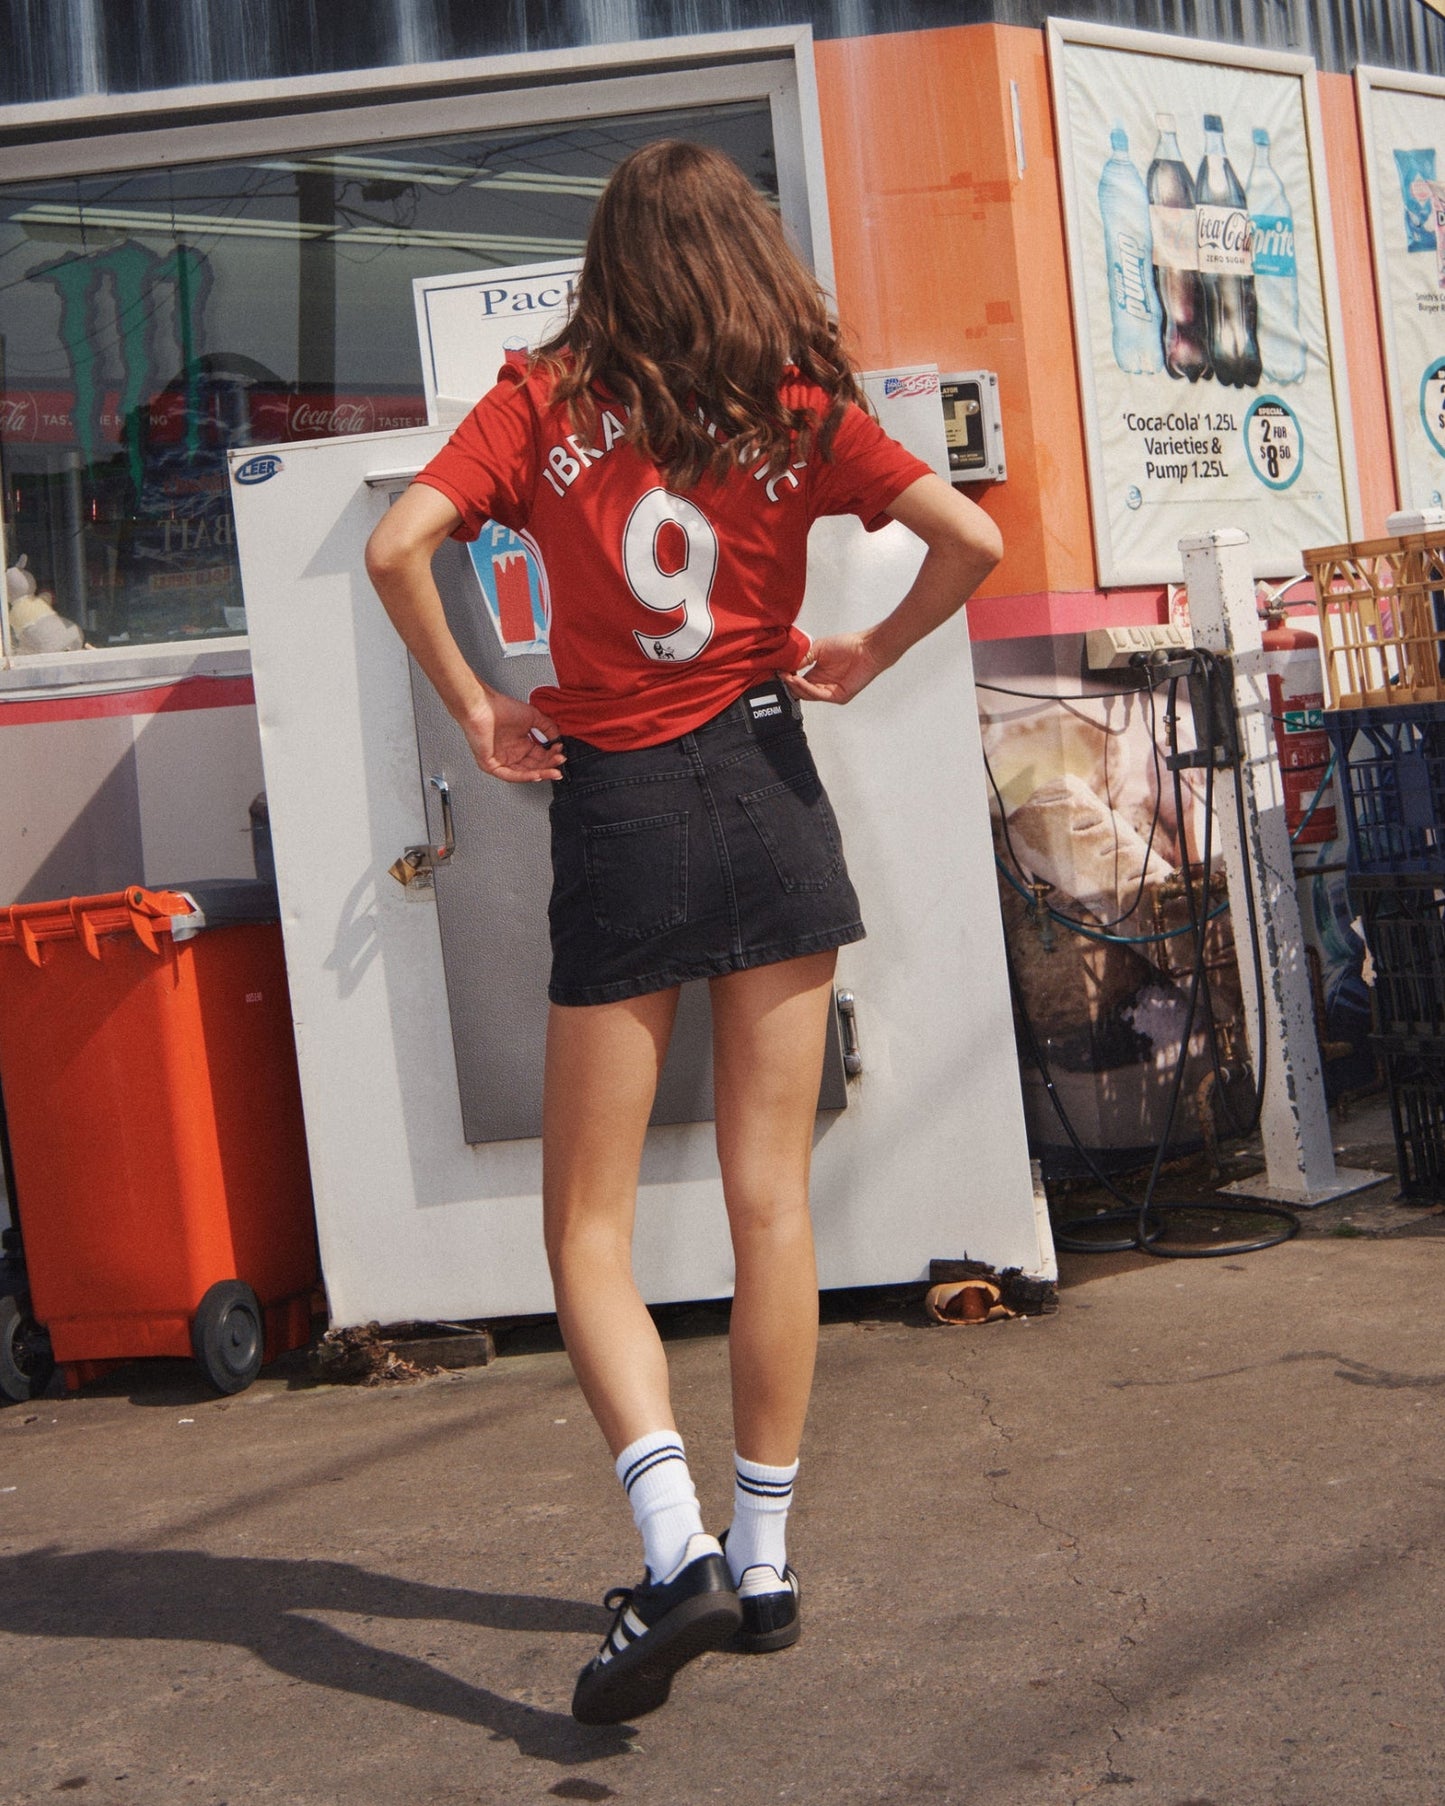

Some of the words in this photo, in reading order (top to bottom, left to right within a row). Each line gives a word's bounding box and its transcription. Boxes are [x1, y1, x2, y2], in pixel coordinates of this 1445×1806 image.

[291, 403, 369, 432] Coca-Cola
[1204, 412, 1238, 431] 1.25L
[1260, 419, 1271, 443] 2
[1273, 426, 1288, 439] FOR
[1144, 436, 1208, 455] Varieties
[1211, 438, 1223, 455] &
[241, 460, 276, 477] LEER
[1145, 460, 1188, 484] Pump
[1191, 460, 1230, 479] 1.25L
[621, 486, 719, 662] 9
